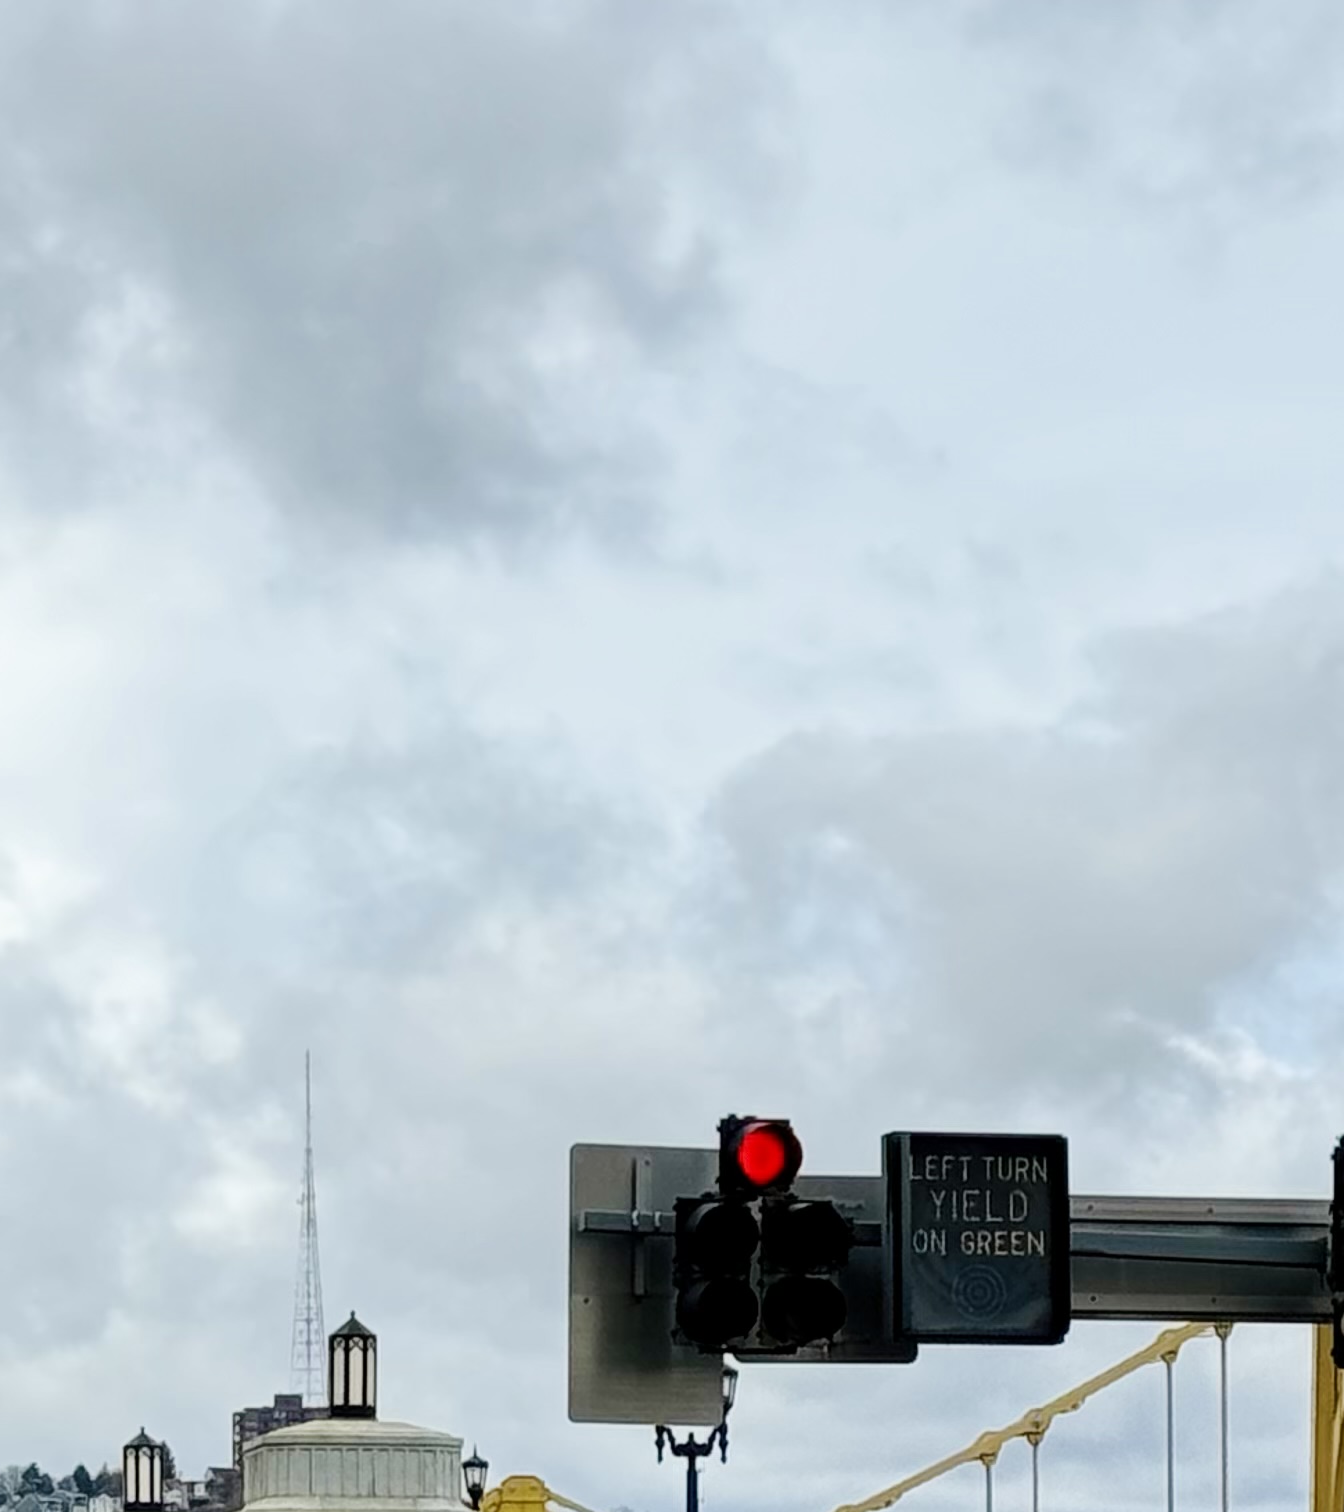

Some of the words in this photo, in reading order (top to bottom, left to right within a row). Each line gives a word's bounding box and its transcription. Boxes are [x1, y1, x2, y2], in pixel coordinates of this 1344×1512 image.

[909, 1155, 972, 1182] LEFT
[981, 1155, 1048, 1183] TURN
[930, 1189, 1028, 1222] YIELD
[912, 1228, 947, 1256] ON
[960, 1229, 1045, 1257] GREEN
